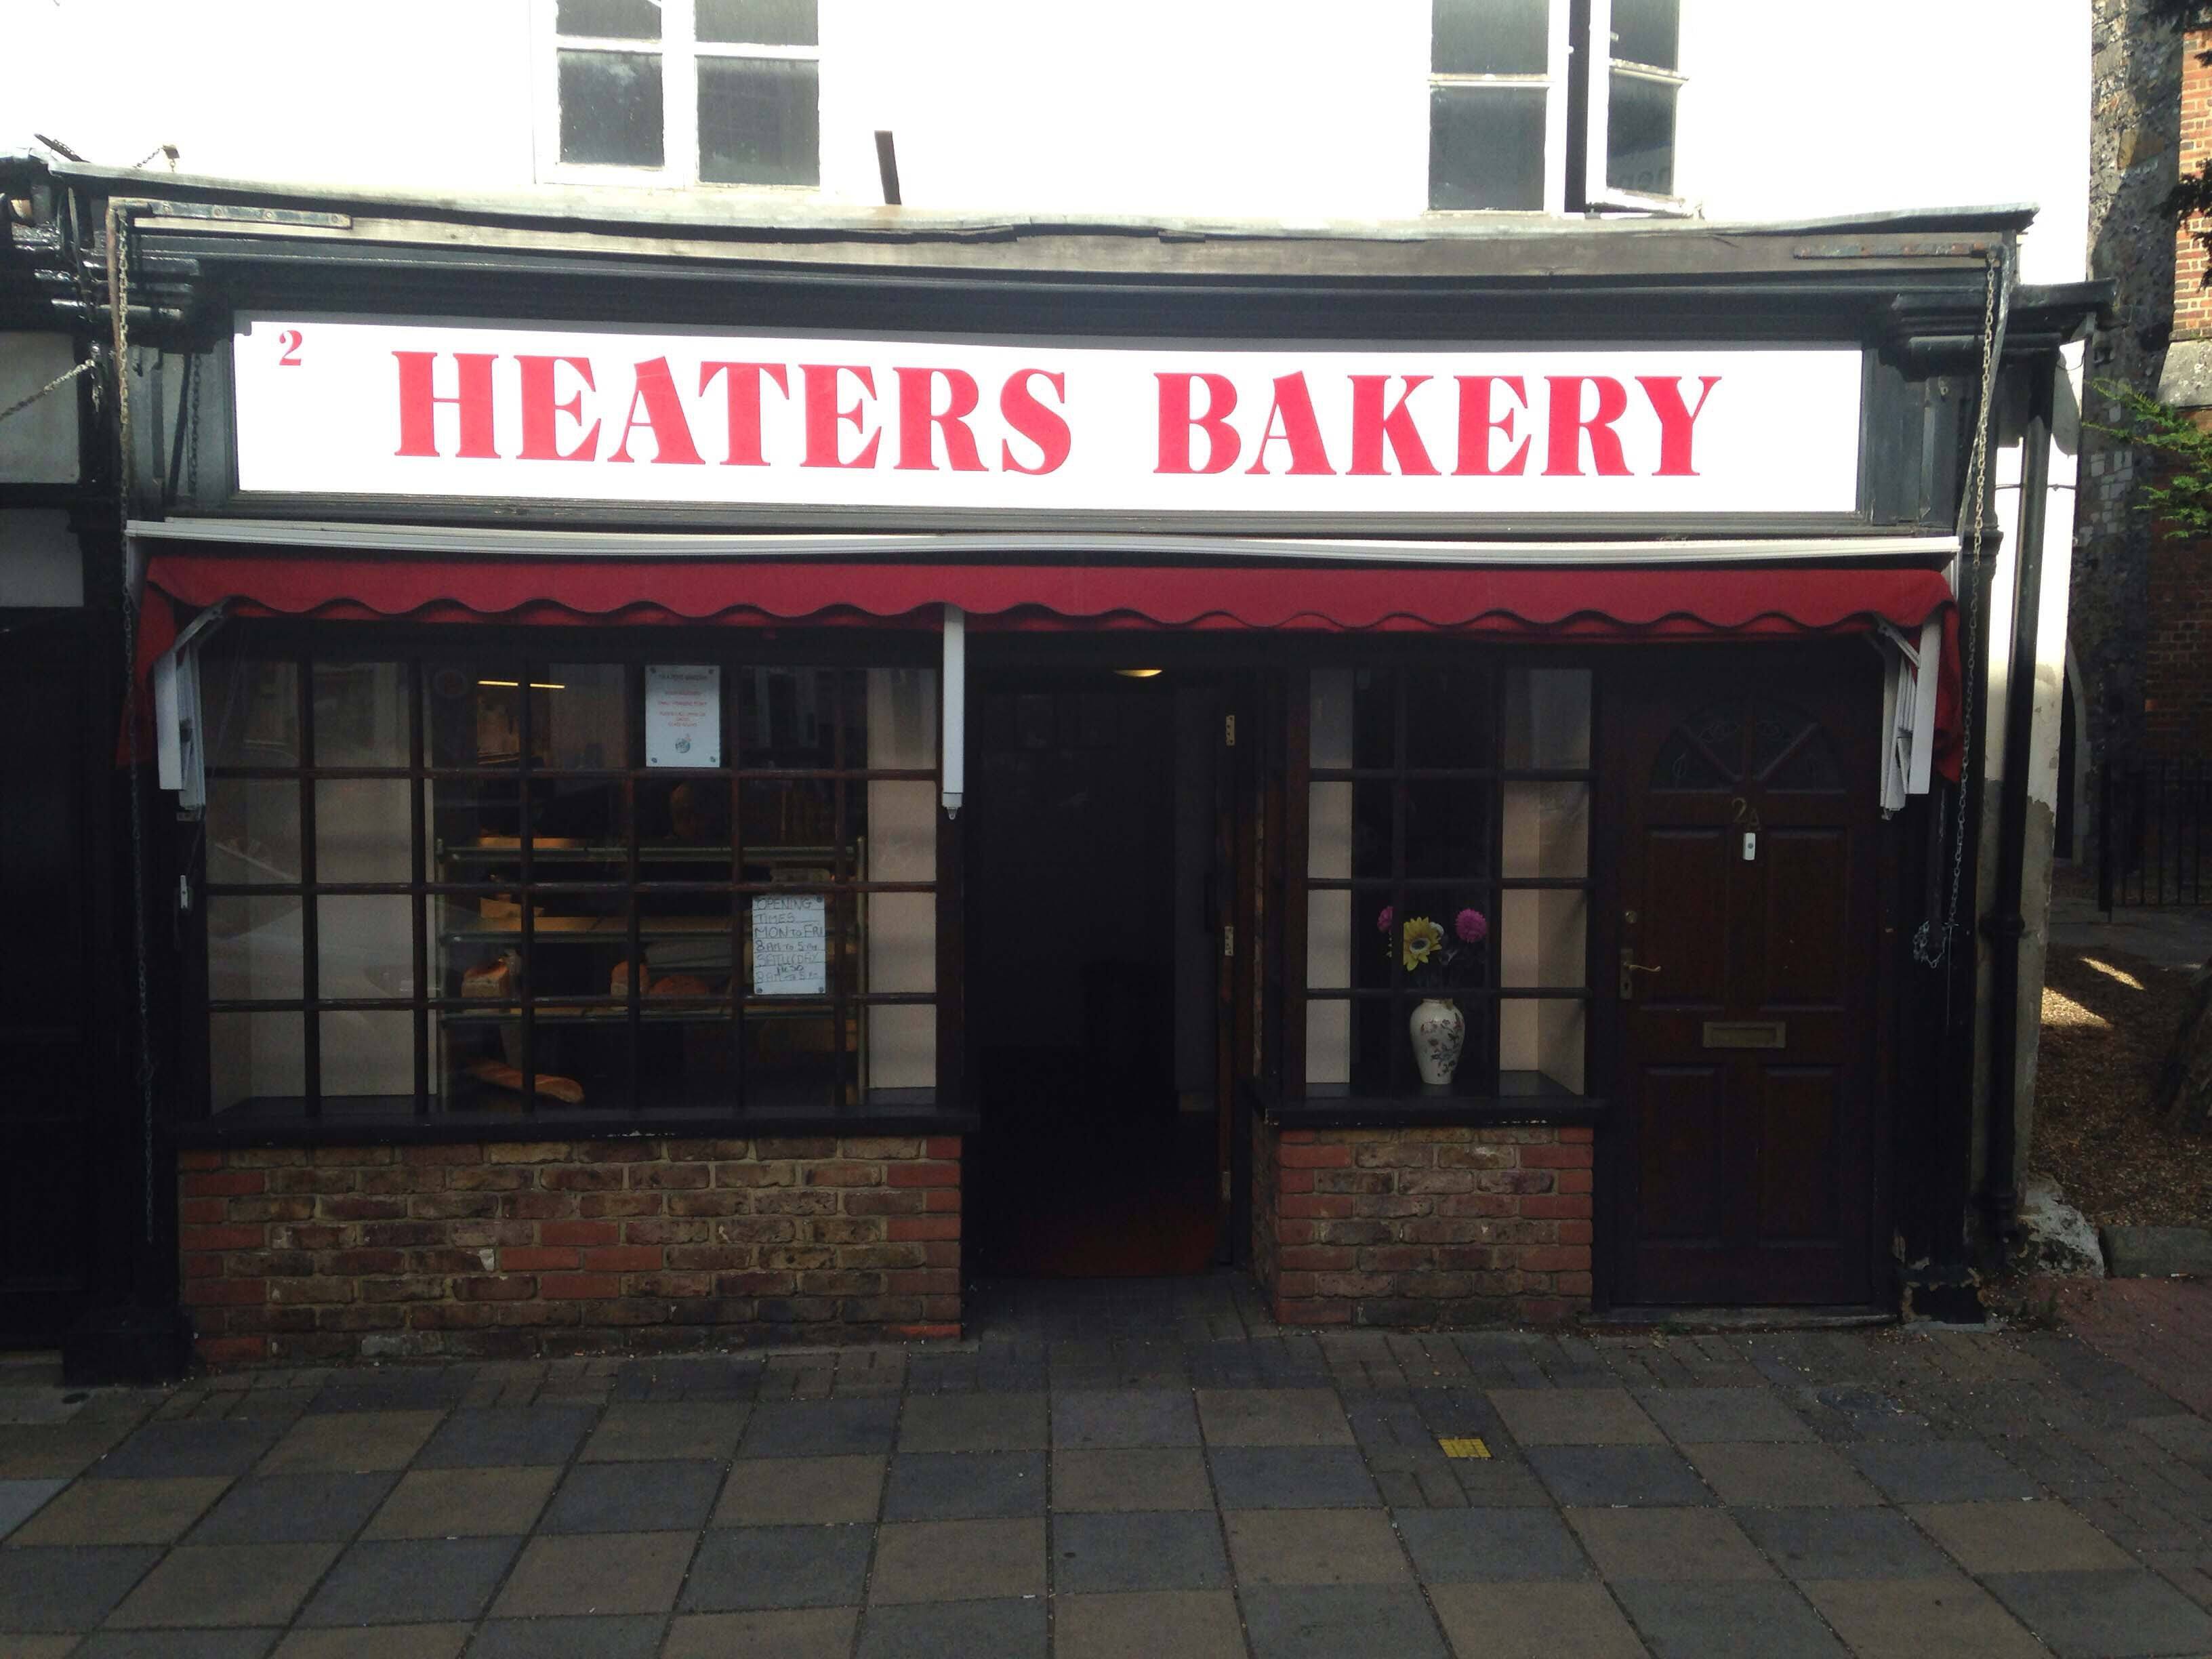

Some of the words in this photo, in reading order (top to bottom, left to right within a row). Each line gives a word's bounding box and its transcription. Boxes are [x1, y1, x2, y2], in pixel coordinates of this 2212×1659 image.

[279, 329, 303, 367] 2
[391, 350, 1072, 476] HEATERS
[1153, 370, 1721, 477] BAKERY
[757, 897, 812, 910] OPENING
[754, 912, 794, 923] TIMES
[754, 926, 787, 938] MON
[804, 924, 823, 937] FRI
